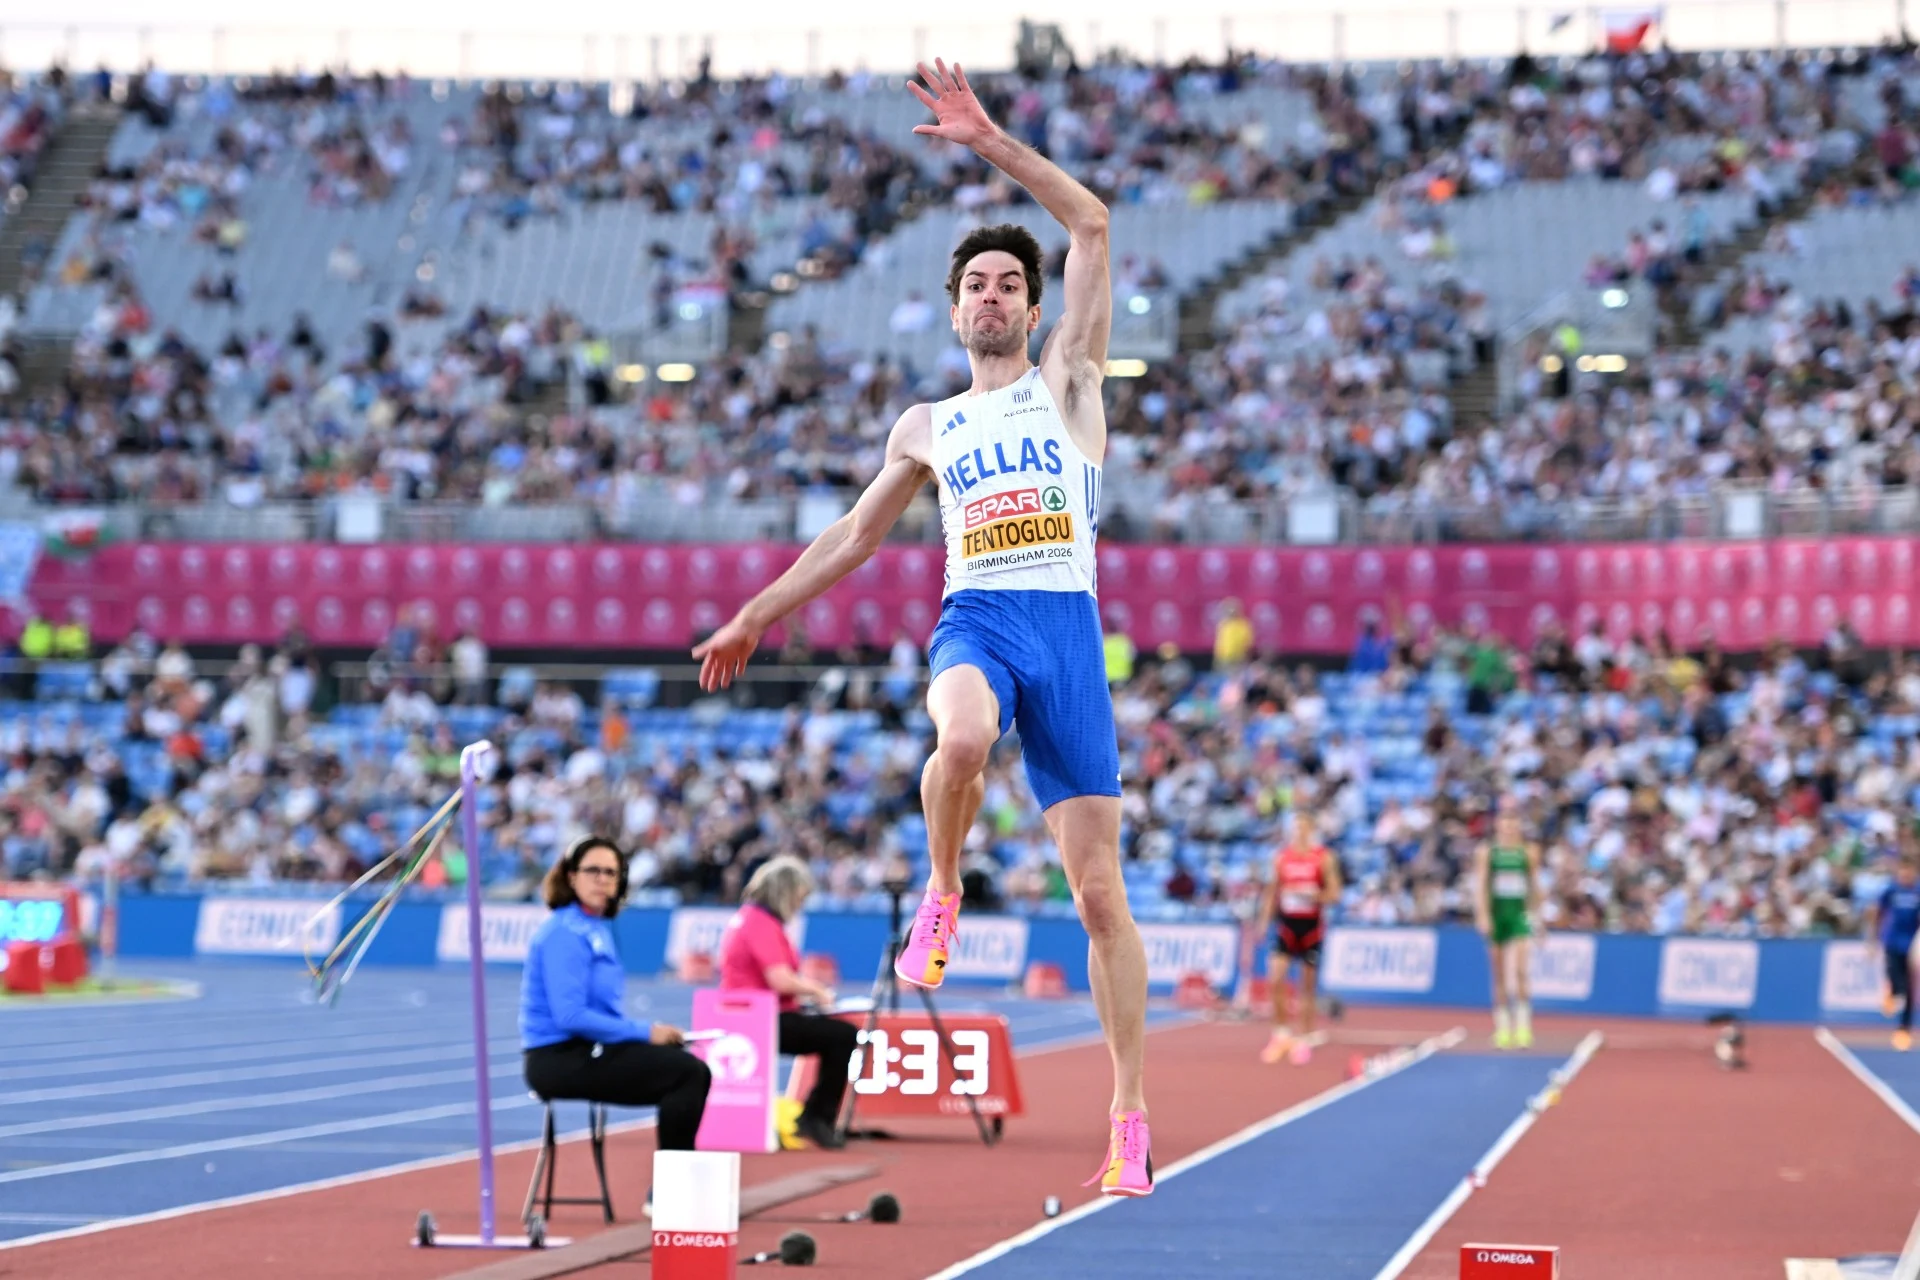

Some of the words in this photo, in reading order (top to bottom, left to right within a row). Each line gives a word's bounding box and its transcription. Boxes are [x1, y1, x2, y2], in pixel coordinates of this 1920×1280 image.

[1004, 406, 1043, 418] AEGEAN
[943, 437, 1063, 498] HELLAS
[967, 493, 1039, 525] SPAR
[964, 517, 1070, 555] TENTOGLOU
[967, 550, 1045, 570] BIRMINGHAM
[1047, 548, 1073, 558] 2026
[672, 1233, 726, 1247] OMEGA
[1490, 1251, 1535, 1264] OMEGA
